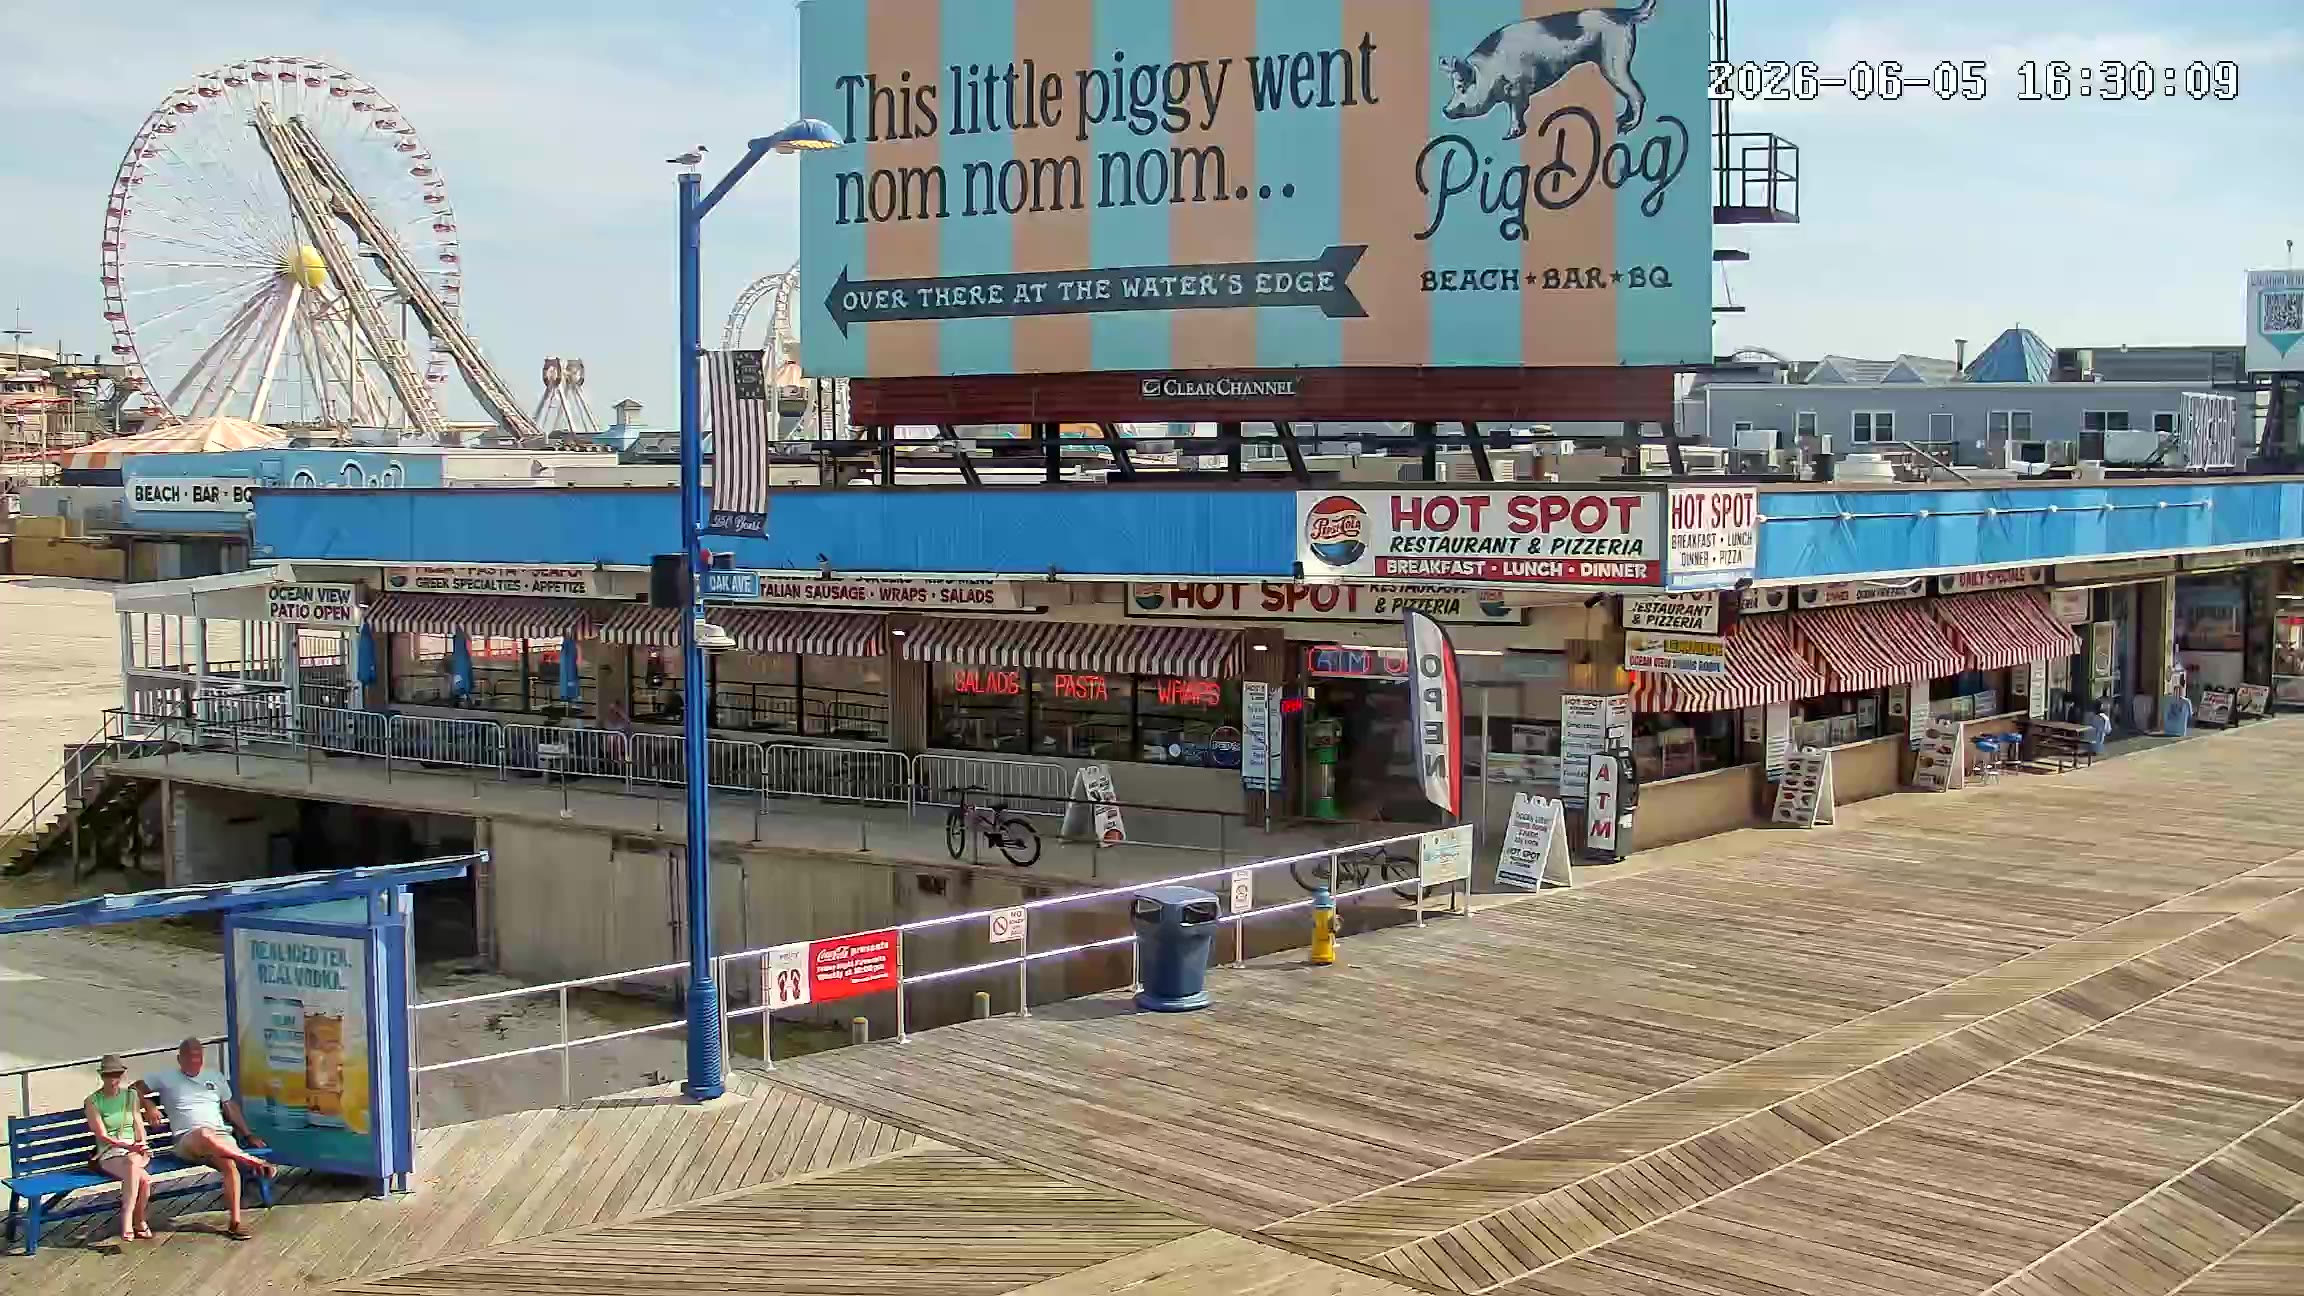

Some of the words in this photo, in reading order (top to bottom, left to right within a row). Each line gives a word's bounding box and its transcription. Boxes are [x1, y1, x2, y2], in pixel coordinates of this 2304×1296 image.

[836, 70, 938, 145] This
[948, 58, 1063, 136] little
[1075, 47, 1232, 142] piggy
[1244, 30, 1380, 112] went
[835, 161, 950, 226] nom
[961, 153, 1085, 217] nom
[1097, 143, 1296, 209] nom...
[1420, 267, 1520, 292] BEACH
[1541, 266, 1607, 290] BAR
[1628, 265, 1673, 289] BQ
[842, 287, 909, 312] OVER
[917, 283, 1001, 309] THERE
[1013, 281, 1048, 305] AT
[1058, 278, 1111, 302] THE
[1120, 273, 1244, 300] WATER'S
[1256, 270, 1336, 294] EDGE
[135, 485, 180, 503] BEACH
[193, 485, 221, 503] BAR
[1390, 495, 1491, 533] HOT
[1507, 495, 1642, 534] SPOT
[1671, 493, 1705, 530] HOT
[1711, 492, 1753, 529] SPOT
[1390, 536, 1521, 555] RESTAURANT
[1527, 536, 1541, 555] &
[1550, 537, 1644, 556] PIZZERIA
[1671, 533, 1716, 549] BREAKFAST
[1727, 532, 1752, 547] LUNCH
[1681, 551, 1708, 566] DINNER
[1719, 549, 1742, 564] PIZZA
[1386, 558, 1486, 577] BREAKFAST
[1503, 561, 1564, 577] LUNCH
[1580, 562, 1648, 579] DINNER
[415, 576, 450, 589] GREEK
[452, 577, 521, 591] SPECIALTIES
[709, 575, 730, 593] OAK
[731, 576, 751, 593] AVE
[760, 583, 800, 599] TALIAN
[804, 584, 866, 601] SAUSAGE
[880, 587, 927, 603] WRAPS
[940, 588, 995, 605] SALADS
[269, 586, 314, 602] OCEAN
[317, 587, 351, 604] VIEW
[1170, 583, 1249, 610] HOT
[1261, 583, 1365, 614] SPOT
[1375, 596, 1387, 614] &
[270, 602, 310, 619] PATIO
[314, 604, 351, 621] OPEN
[1631, 613, 1641, 625] &
[1646, 614, 1704, 629] PIZZERIA
[954, 670, 1020, 695] SALADS
[1055, 673, 1108, 700] PASTA
[1590, 763, 1612, 839] ATM
